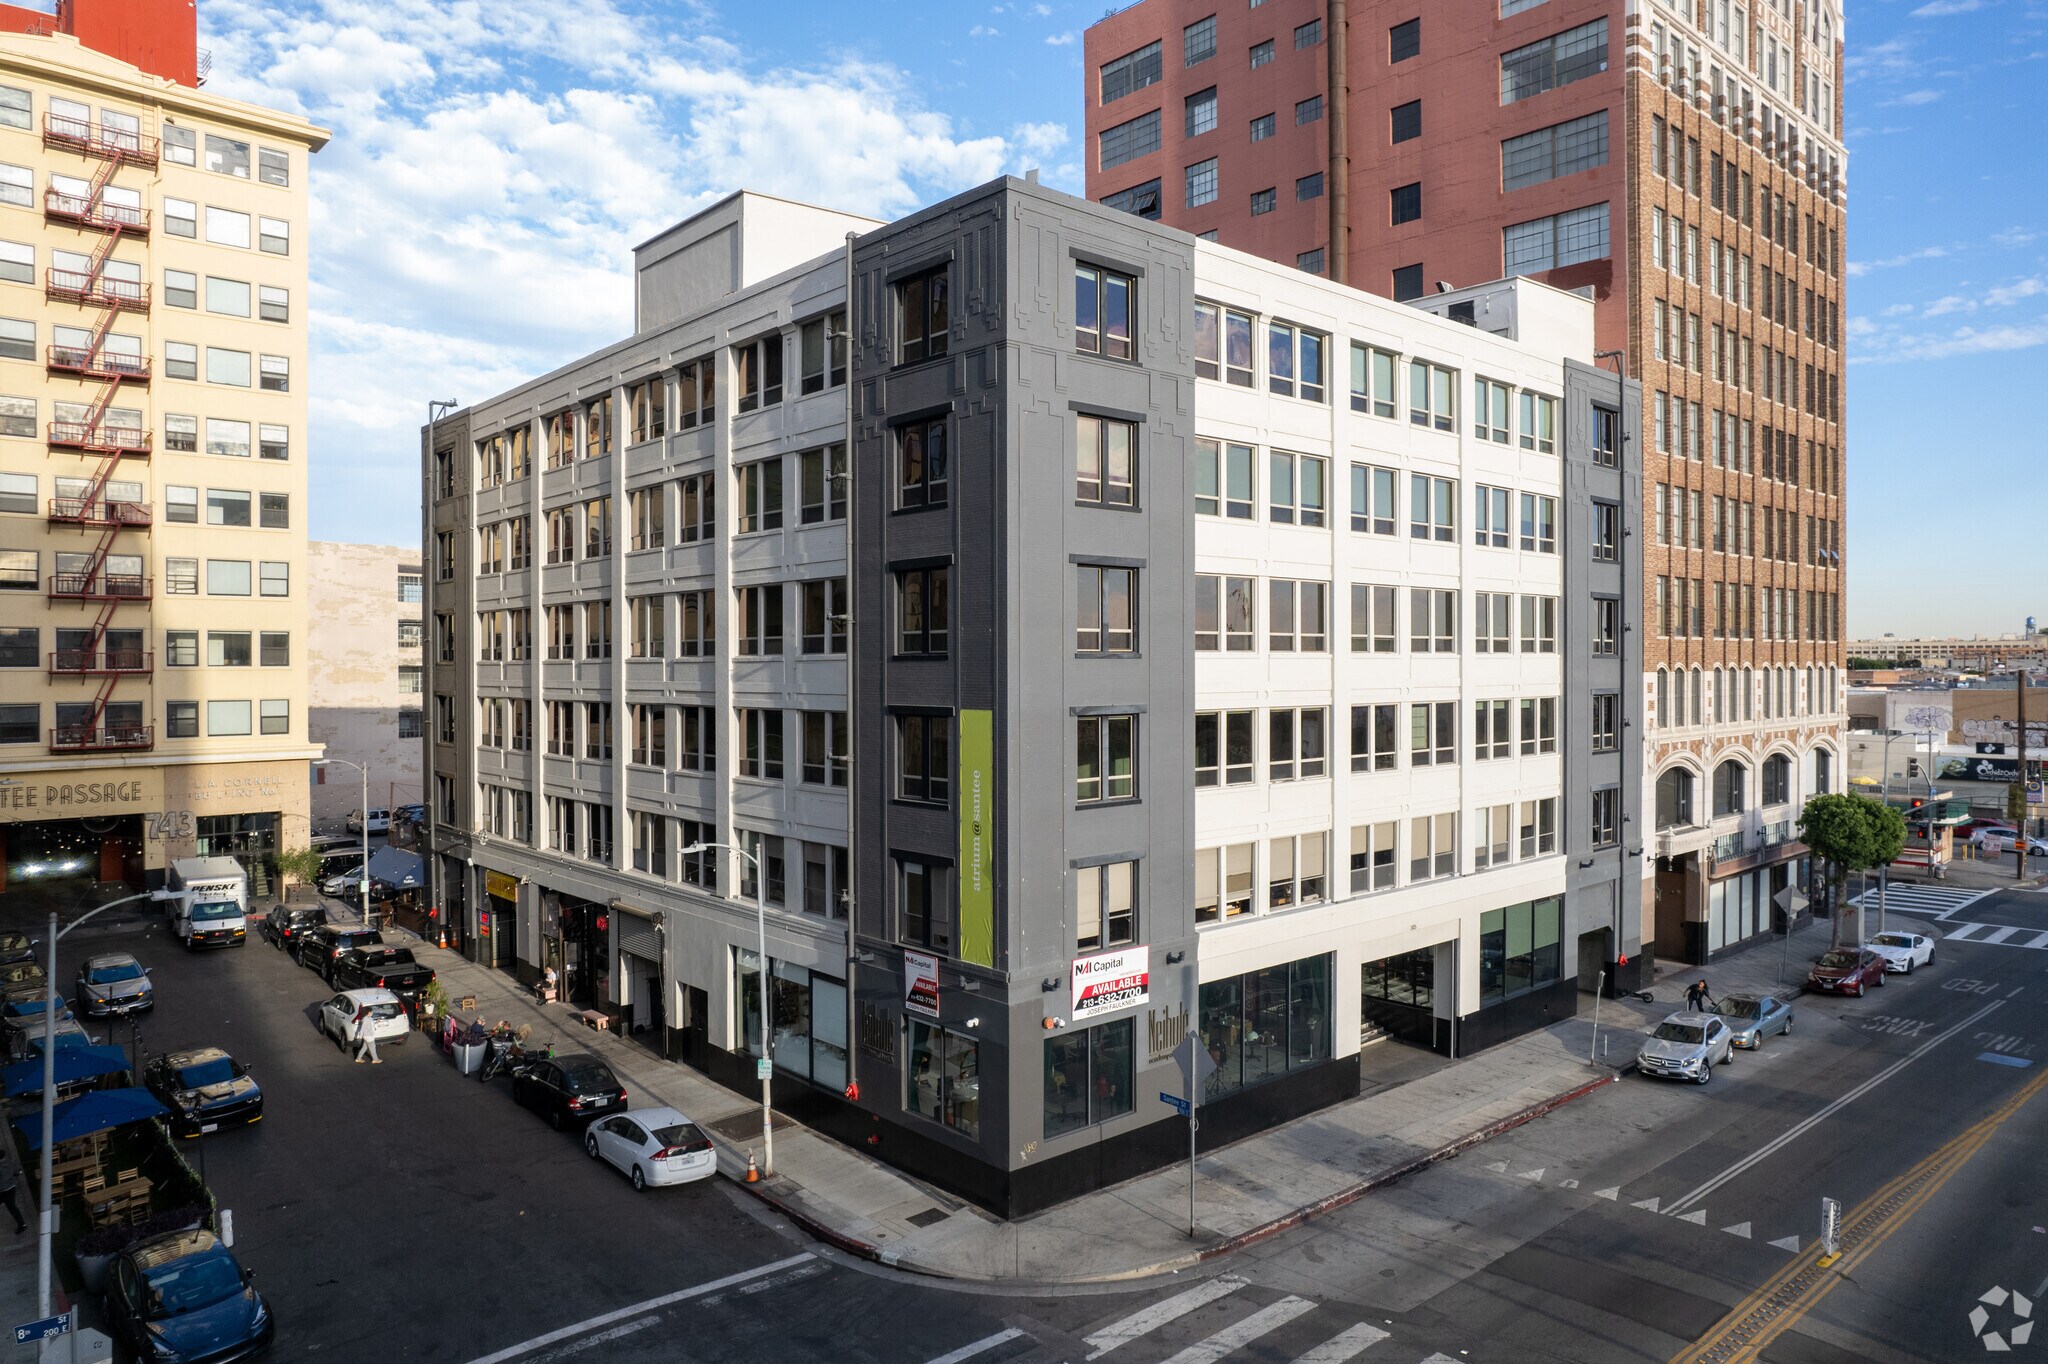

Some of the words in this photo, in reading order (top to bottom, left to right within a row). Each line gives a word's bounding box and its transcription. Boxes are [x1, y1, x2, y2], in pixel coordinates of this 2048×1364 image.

[46, 781, 142, 806] PASSAGE
[144, 810, 196, 840] 743
[971, 769, 982, 892] atrium@santee
[191, 882, 239, 892] PENSKE
[1075, 961, 1092, 976] NAI
[1093, 957, 1123, 972] Capital
[915, 981, 936, 992] AVAILABLE
[1092, 975, 1142, 996] AVAILABLE
[1082, 986, 1142, 1008] 213-632-7700
[1086, 1005, 1109, 1016] JOSEPH
[1109, 998, 1136, 1010] FAULKNER
[57, 1315, 67, 1324] St
[43, 1327, 60, 1338] 200
[61, 1324, 68, 1333] E
